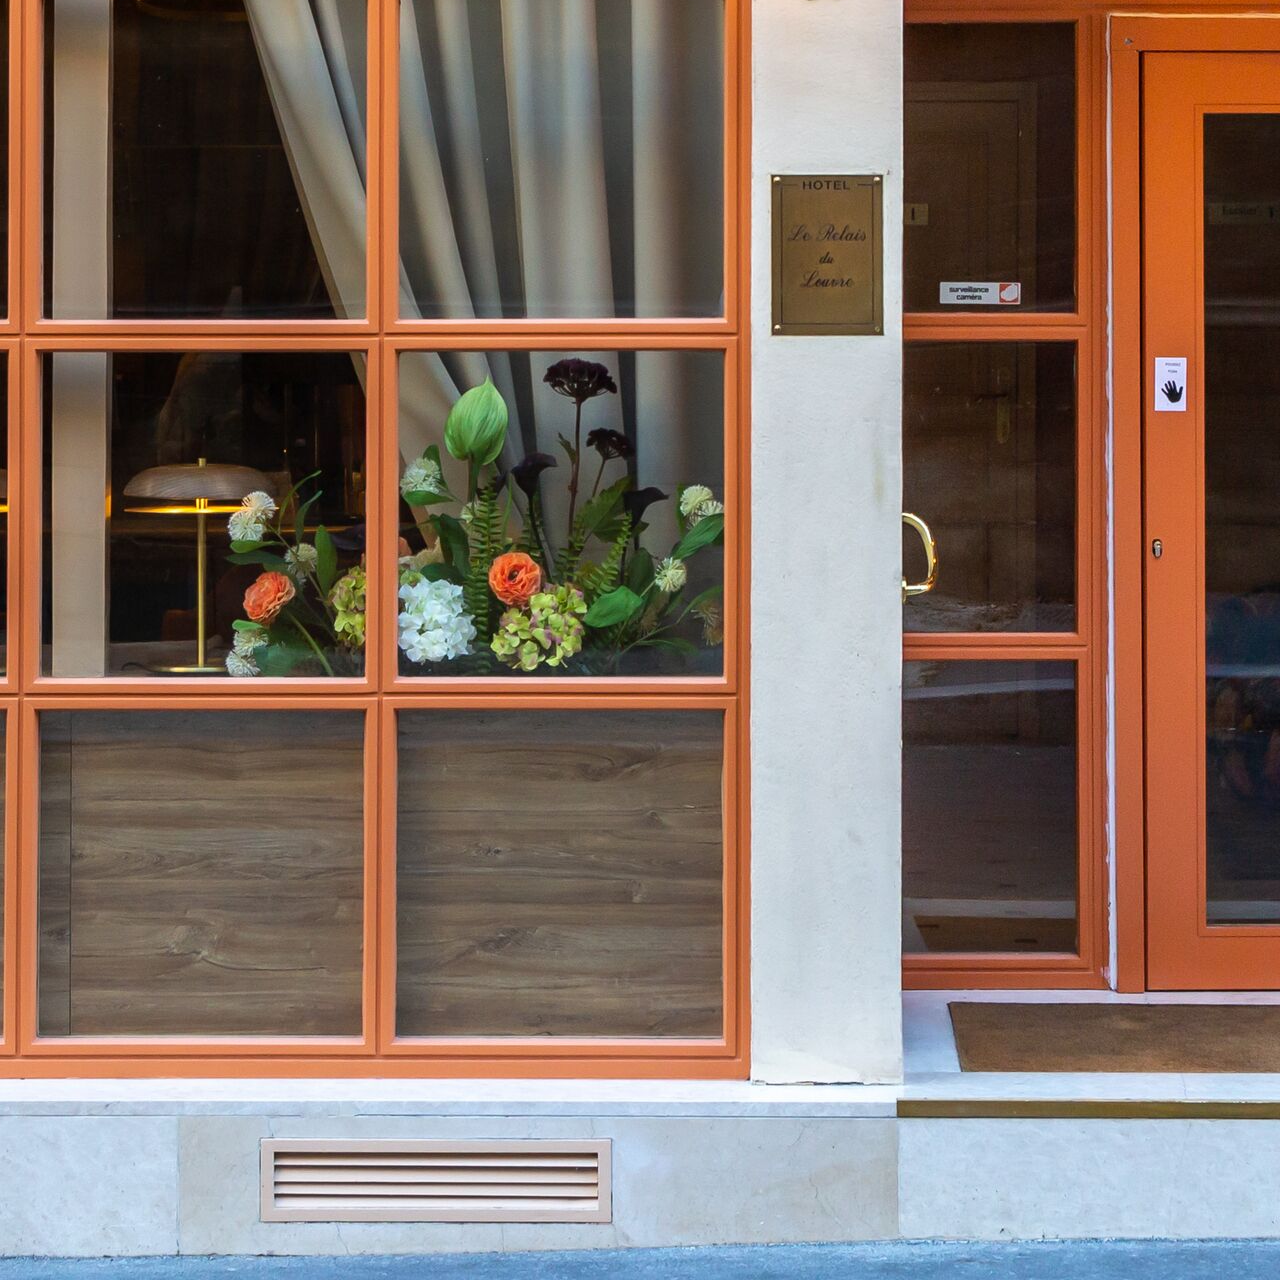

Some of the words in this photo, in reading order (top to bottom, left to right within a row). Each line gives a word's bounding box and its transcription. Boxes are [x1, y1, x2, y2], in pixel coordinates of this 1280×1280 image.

[802, 180, 851, 191] HOTEL
[787, 223, 811, 241] Le
[816, 223, 867, 241] Relais
[818, 251, 835, 264] du
[800, 270, 853, 288] Louvre
